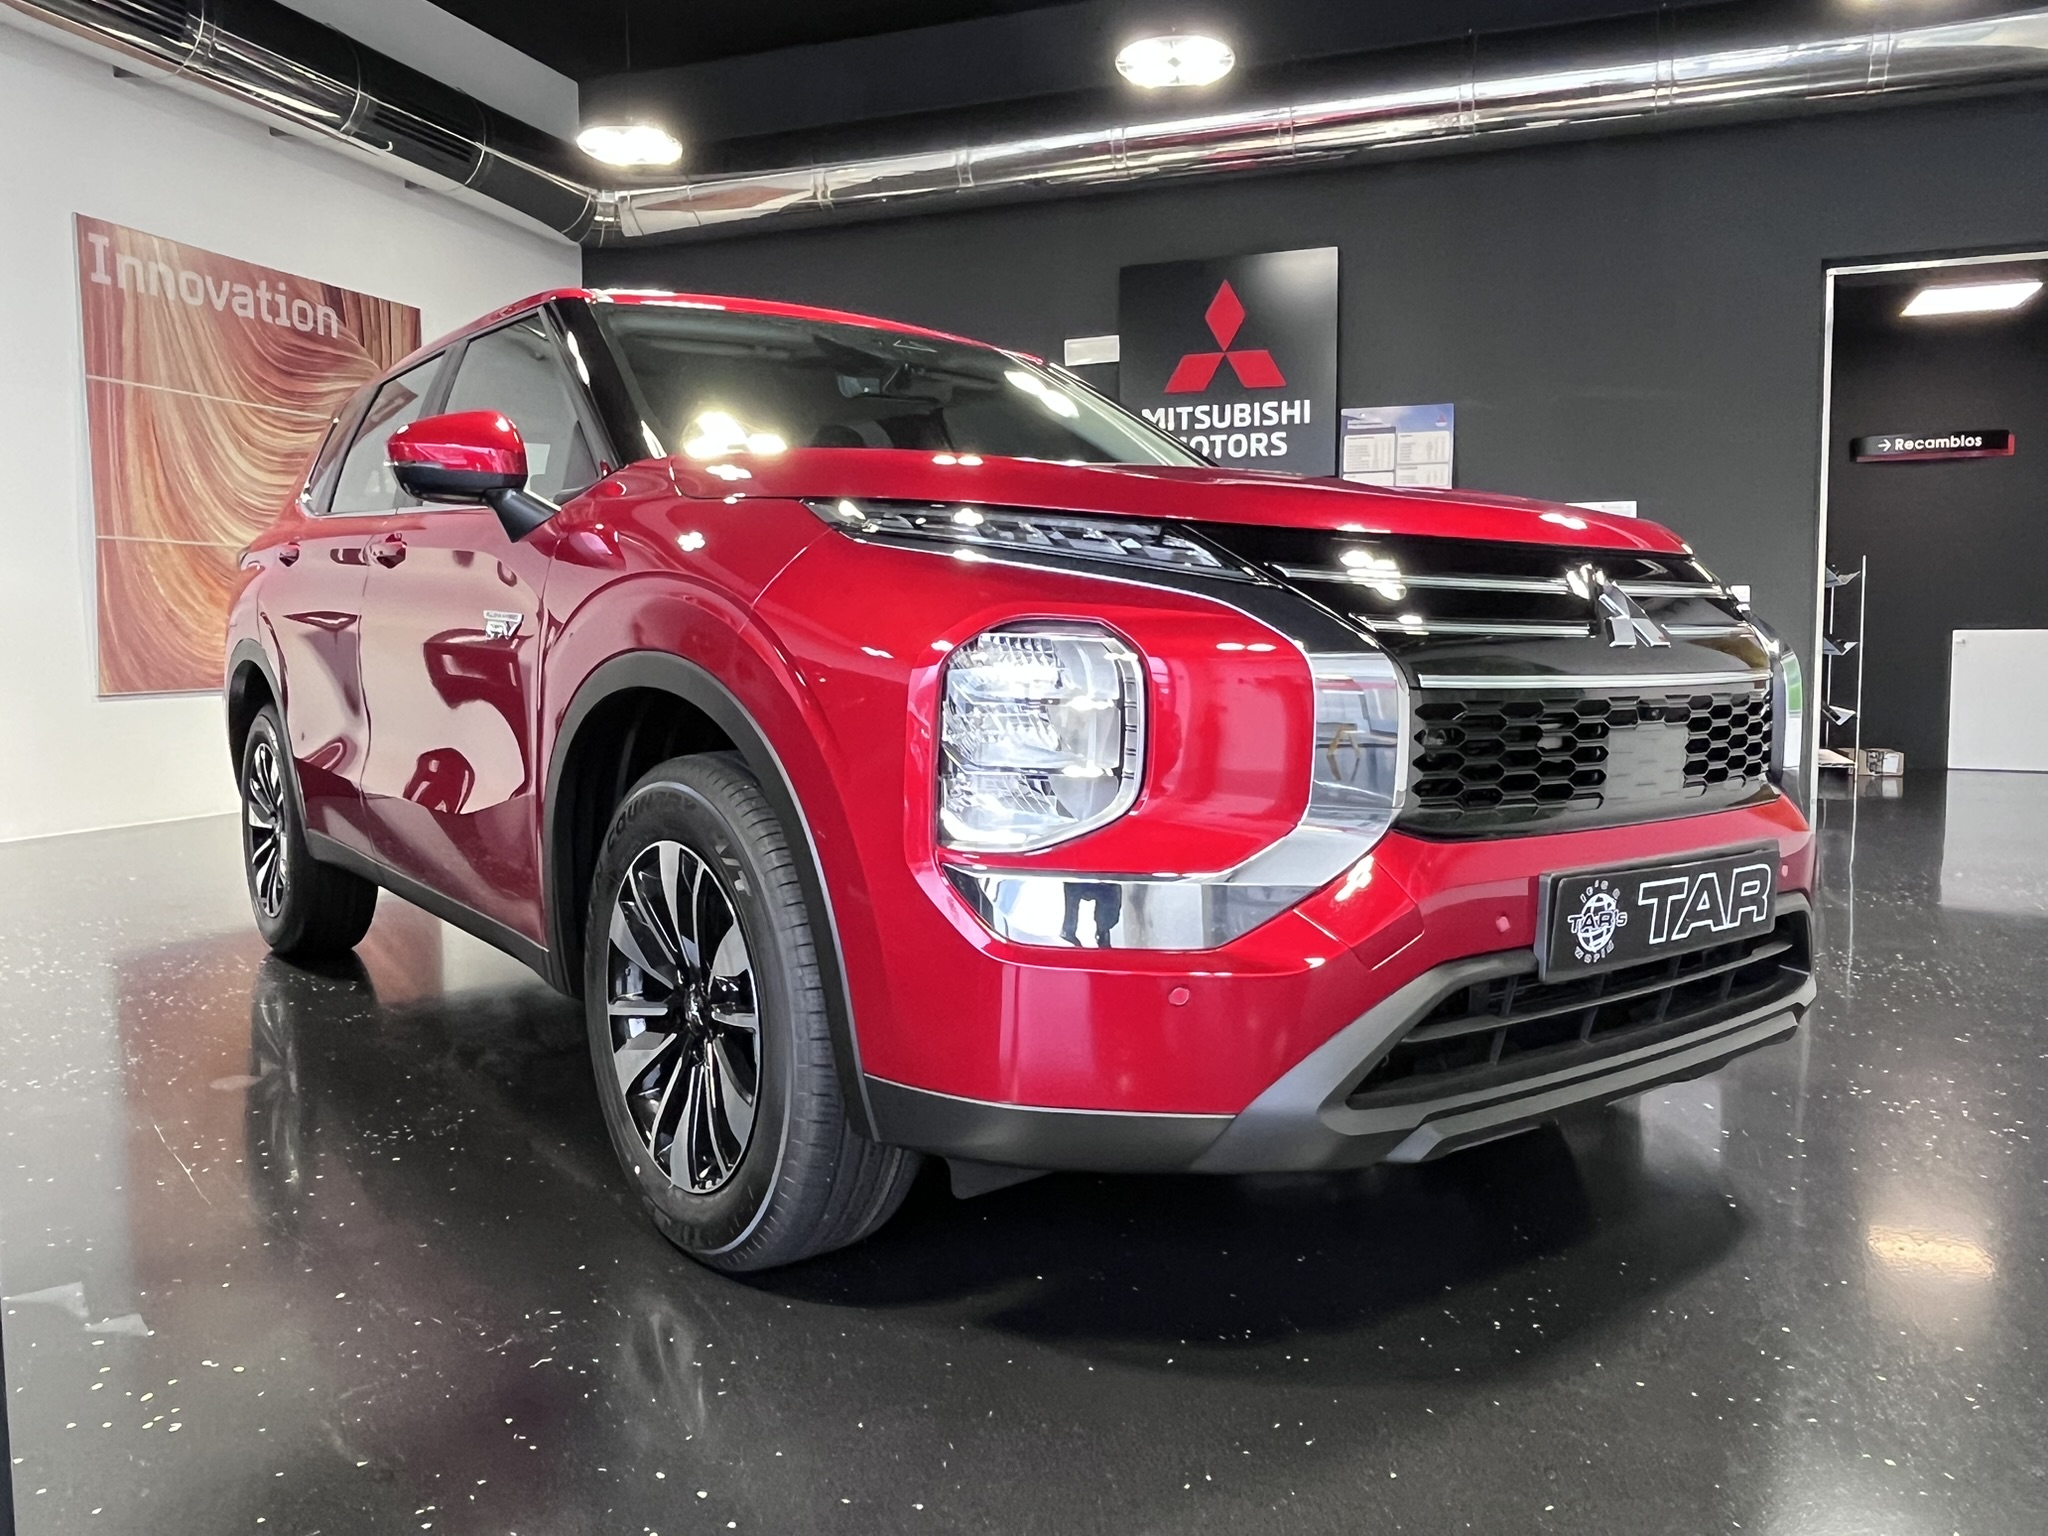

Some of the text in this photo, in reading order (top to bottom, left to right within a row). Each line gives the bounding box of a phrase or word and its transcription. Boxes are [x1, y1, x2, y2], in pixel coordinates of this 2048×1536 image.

[88, 232, 338, 338] Innovation
[1142, 399, 1311, 431] MITSUBISHI
[1178, 431, 1288, 459] OTORS
[1894, 434, 1983, 451] Recambios
[1637, 863, 1772, 945] TAR
